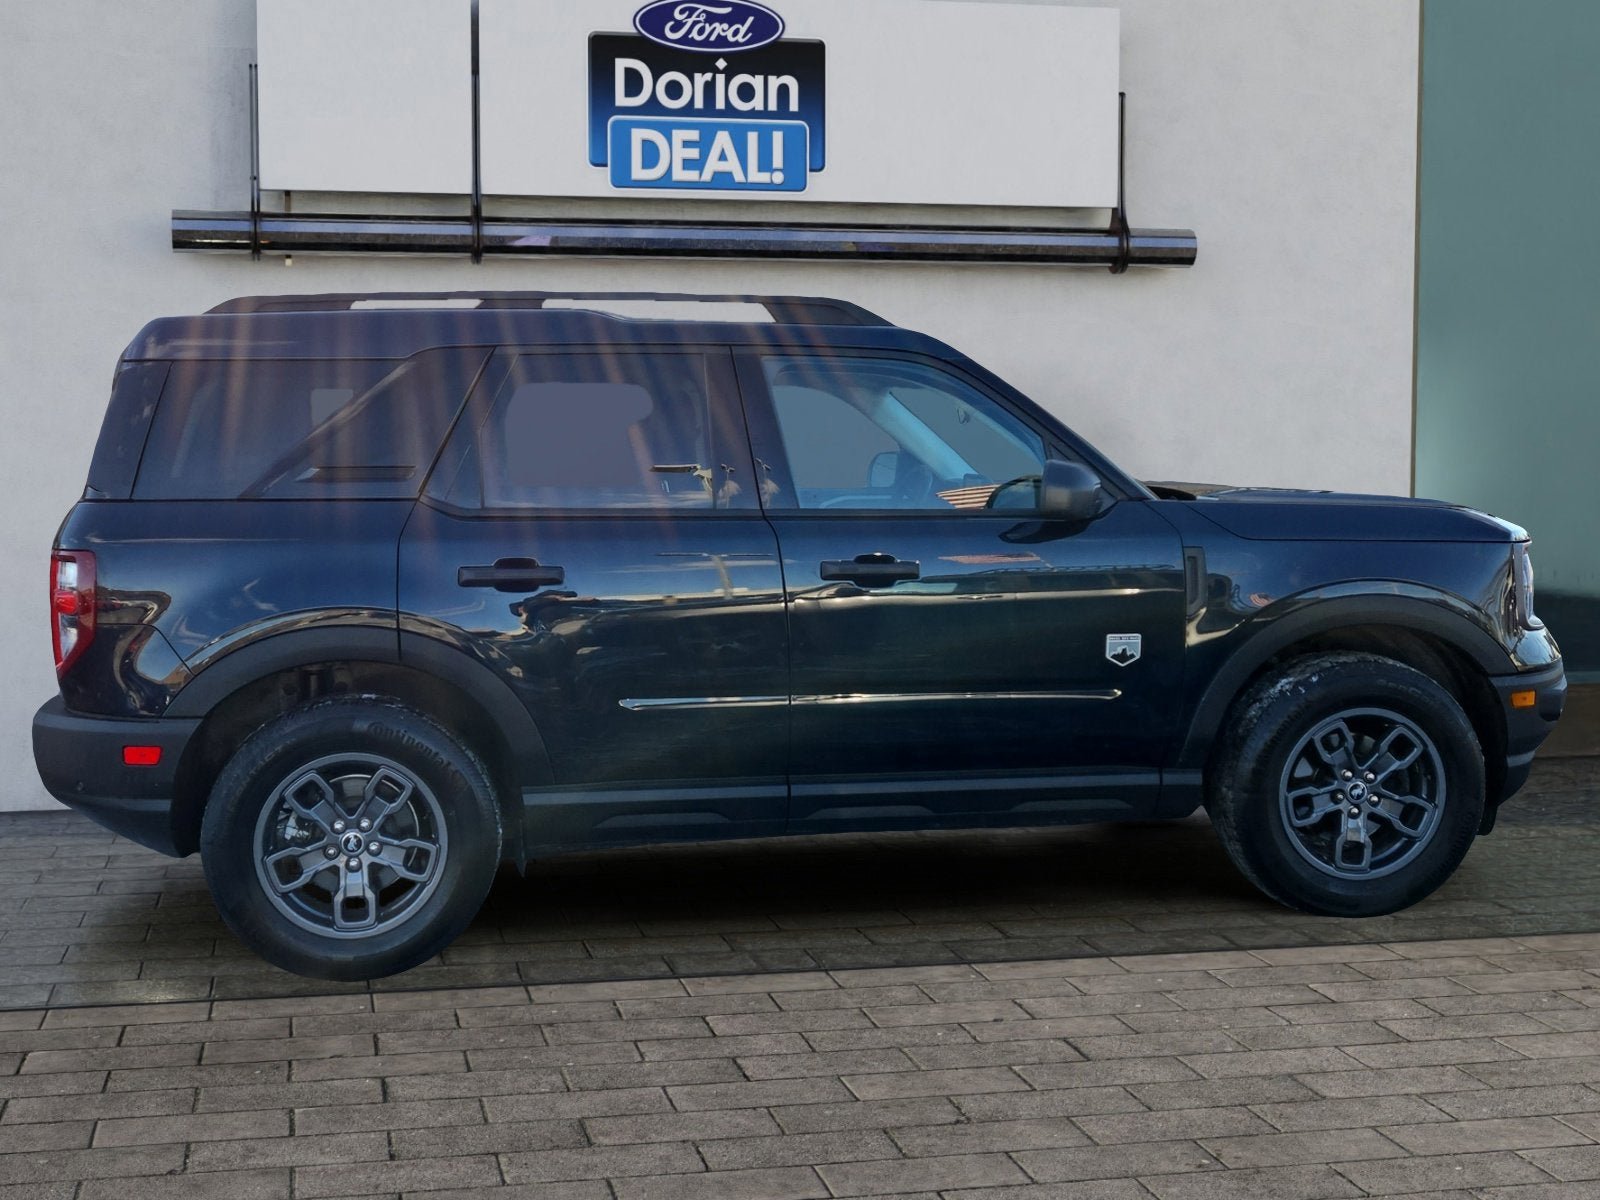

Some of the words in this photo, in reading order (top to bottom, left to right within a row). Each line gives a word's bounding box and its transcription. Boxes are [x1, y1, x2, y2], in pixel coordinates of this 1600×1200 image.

[664, 3, 755, 43] Ford
[614, 57, 799, 112] Dorian
[630, 128, 785, 185] DEAL!
